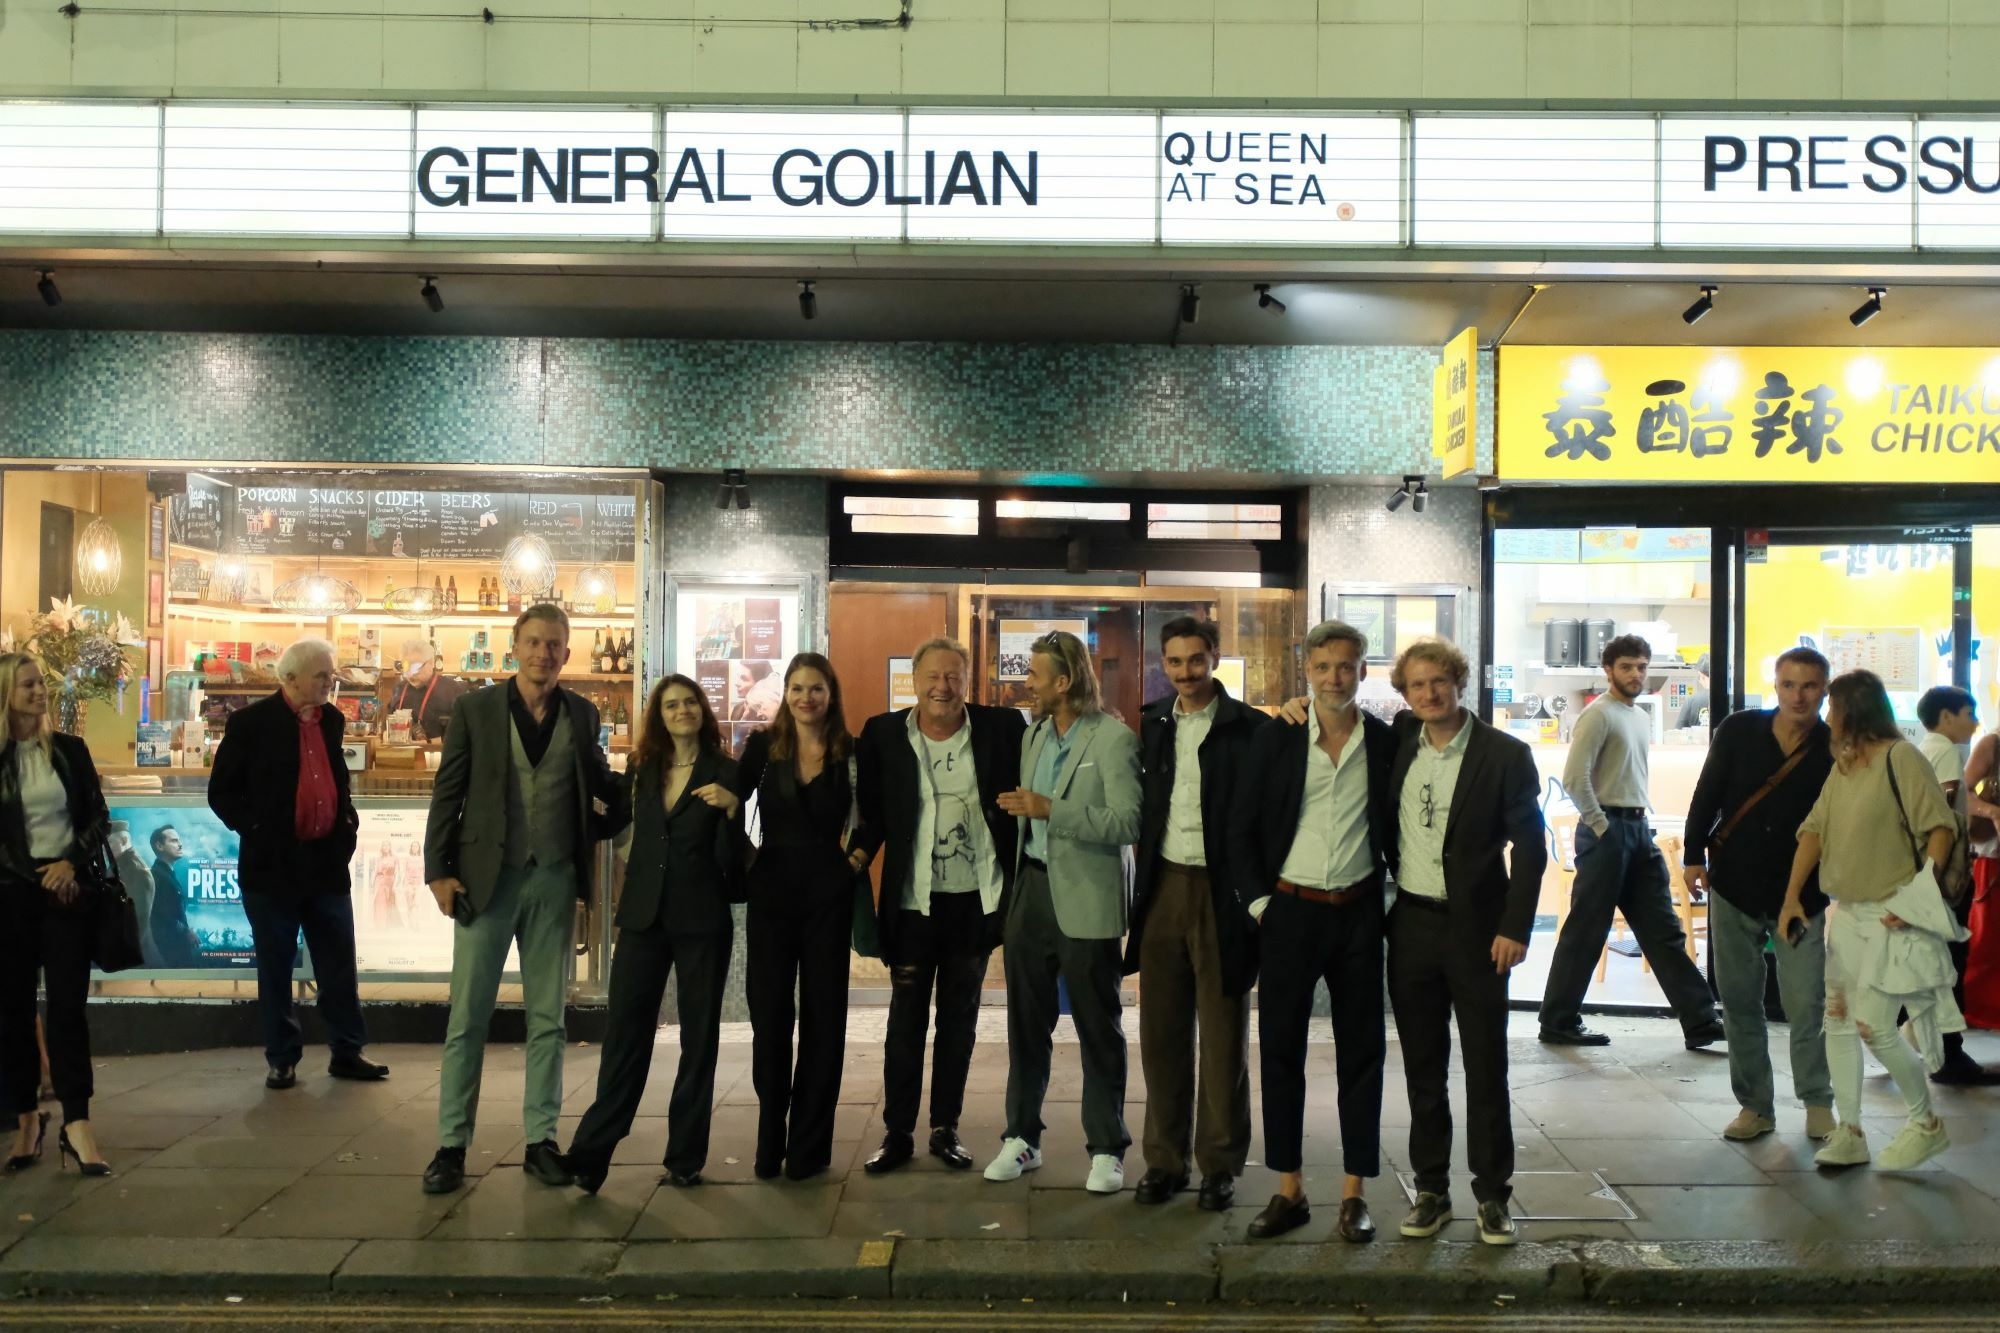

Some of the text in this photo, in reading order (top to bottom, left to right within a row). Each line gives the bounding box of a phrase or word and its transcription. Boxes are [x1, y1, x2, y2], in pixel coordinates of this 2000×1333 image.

[1164, 131, 1326, 167] QUEEN
[417, 147, 1038, 207] GENERAL GOLIAN
[1167, 172, 1326, 205] AT SEA
[238, 487, 297, 502] POPCORN
[308, 488, 365, 505] SNACKS
[374, 490, 426, 507] CIDER
[440, 493, 491, 508] BEERS
[529, 500, 557, 515] RED
